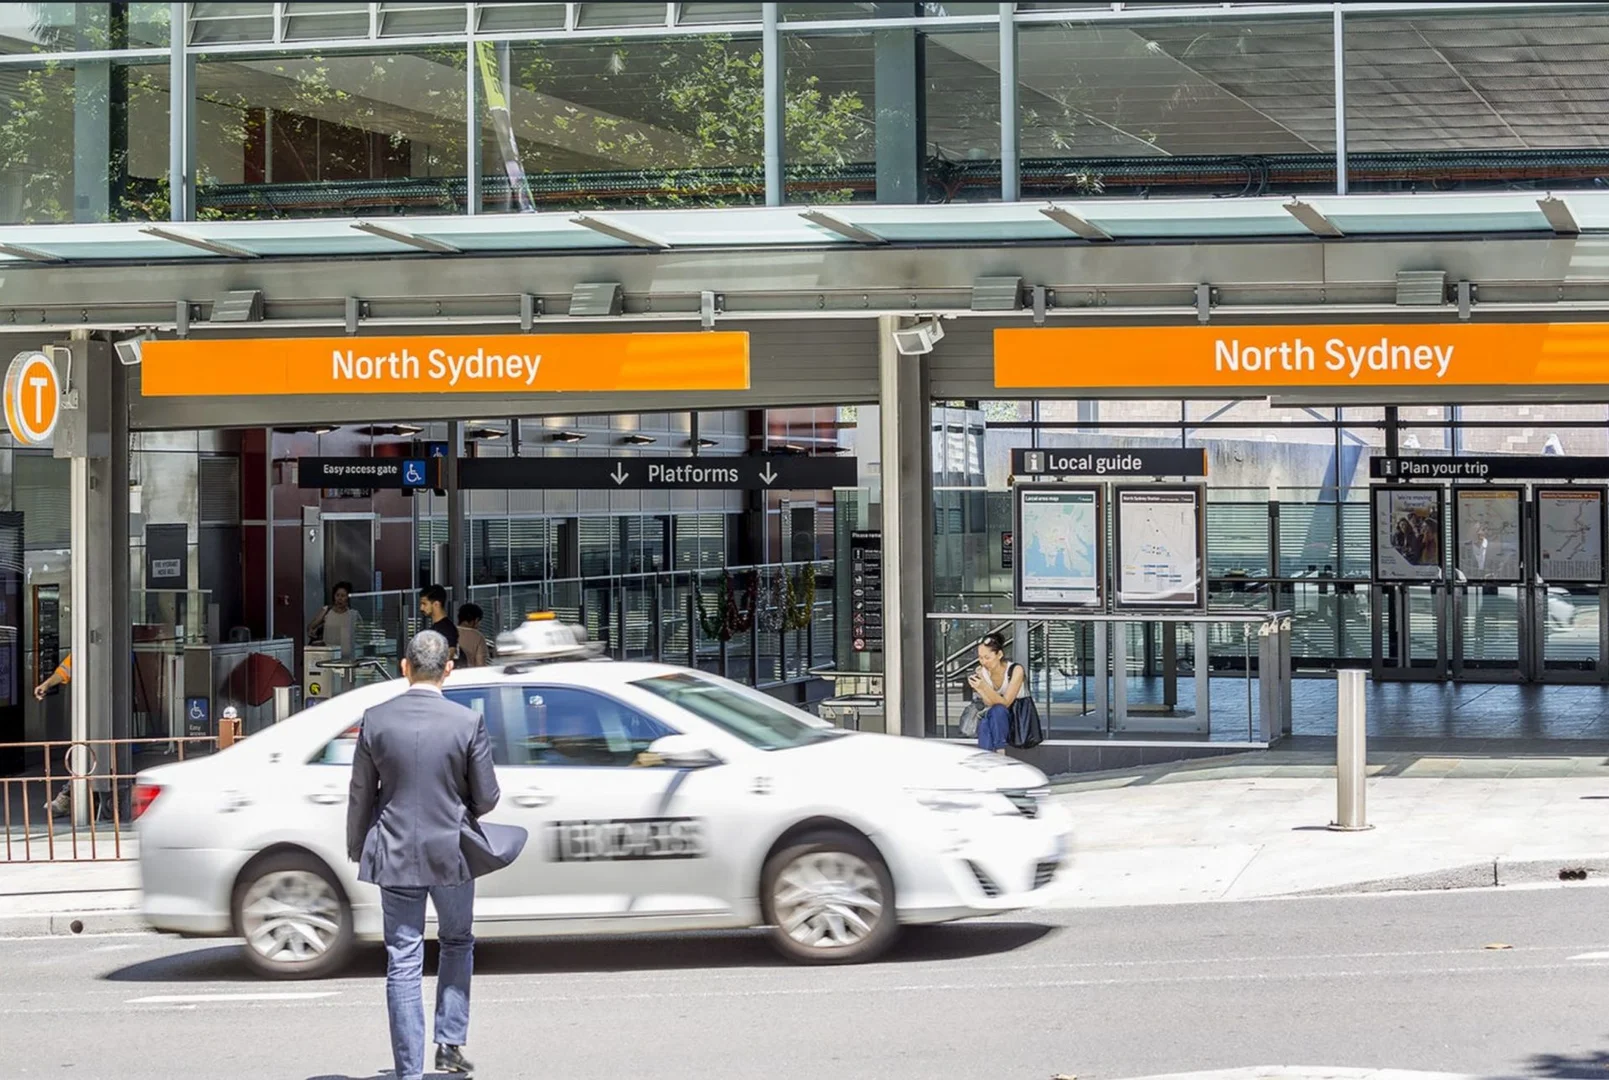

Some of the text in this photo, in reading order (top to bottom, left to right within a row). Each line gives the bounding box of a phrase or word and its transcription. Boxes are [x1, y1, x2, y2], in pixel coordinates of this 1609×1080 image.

[332, 348, 542, 386] North Sydney
[1215, 338, 1454, 379] North Sydney
[29, 377, 48, 424] T
[323, 464, 398, 476] Easy access gate
[648, 464, 739, 483] Platforms
[1049, 454, 1092, 470] Local
[1096, 454, 1142, 474] guide
[1400, 461, 1430, 474] Plan
[1432, 463, 1463, 477] your
[1464, 461, 1489, 476] trip
